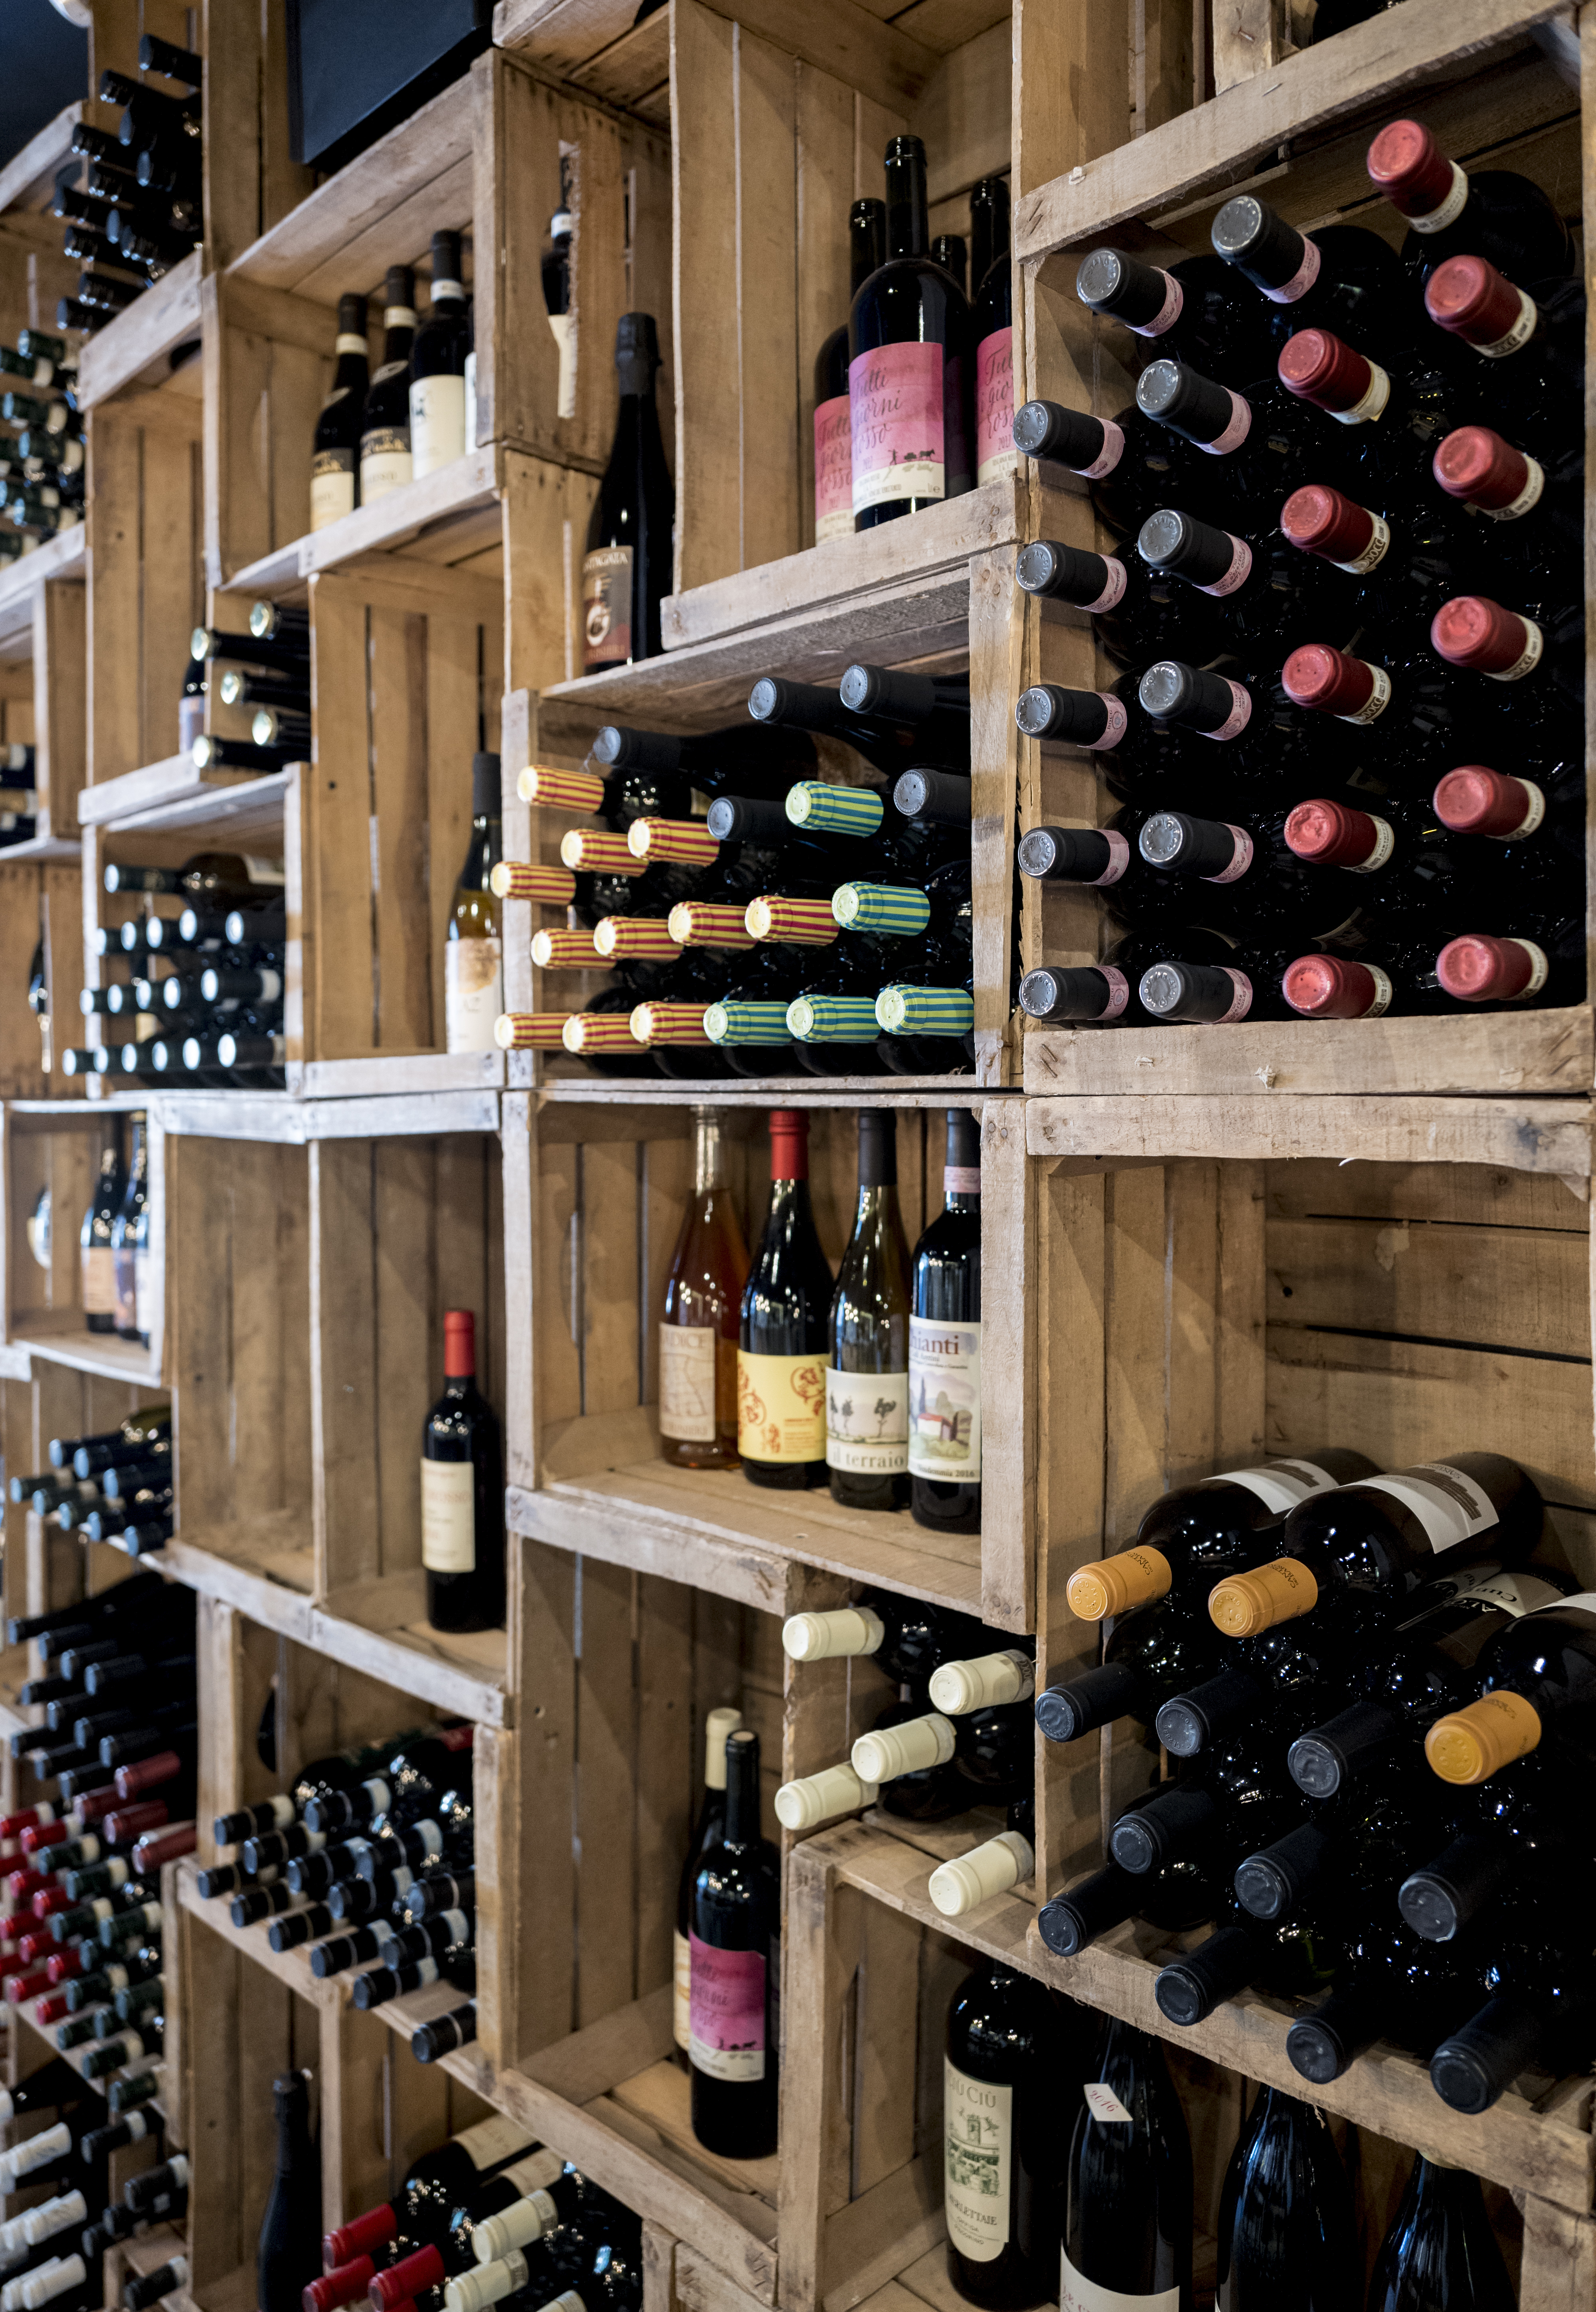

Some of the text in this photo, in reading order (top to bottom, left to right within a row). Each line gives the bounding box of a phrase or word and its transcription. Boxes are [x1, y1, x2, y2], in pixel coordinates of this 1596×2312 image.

[1361, 697, 1383, 717] DOCG
[845, 1451, 904, 1469] terraio
[1089, 2090, 1118, 2112] 2016
